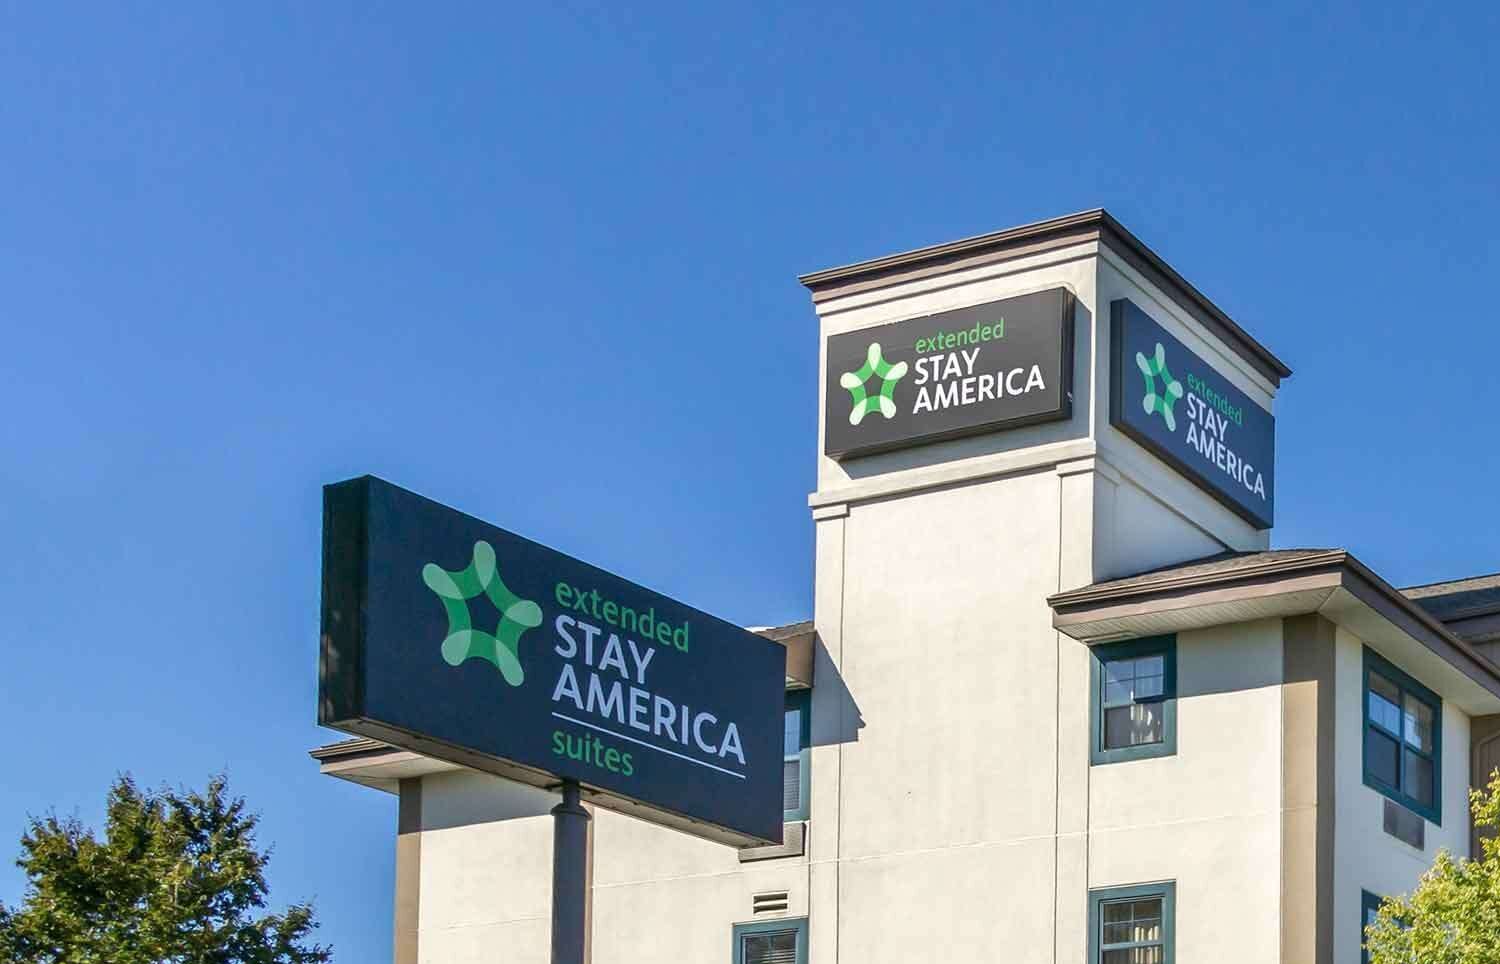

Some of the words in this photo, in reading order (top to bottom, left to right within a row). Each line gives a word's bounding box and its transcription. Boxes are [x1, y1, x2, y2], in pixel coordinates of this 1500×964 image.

[915, 317, 1004, 353] extended
[912, 364, 1046, 414] AMERICA
[914, 347, 980, 385] STAY
[1187, 373, 1242, 425] extended
[1187, 392, 1228, 441] STAY
[1186, 422, 1265, 500] AMERICA
[555, 582, 689, 653] extended
[554, 614, 656, 684] STAY
[552, 663, 747, 766] AMERICA
[553, 730, 634, 776] suites
